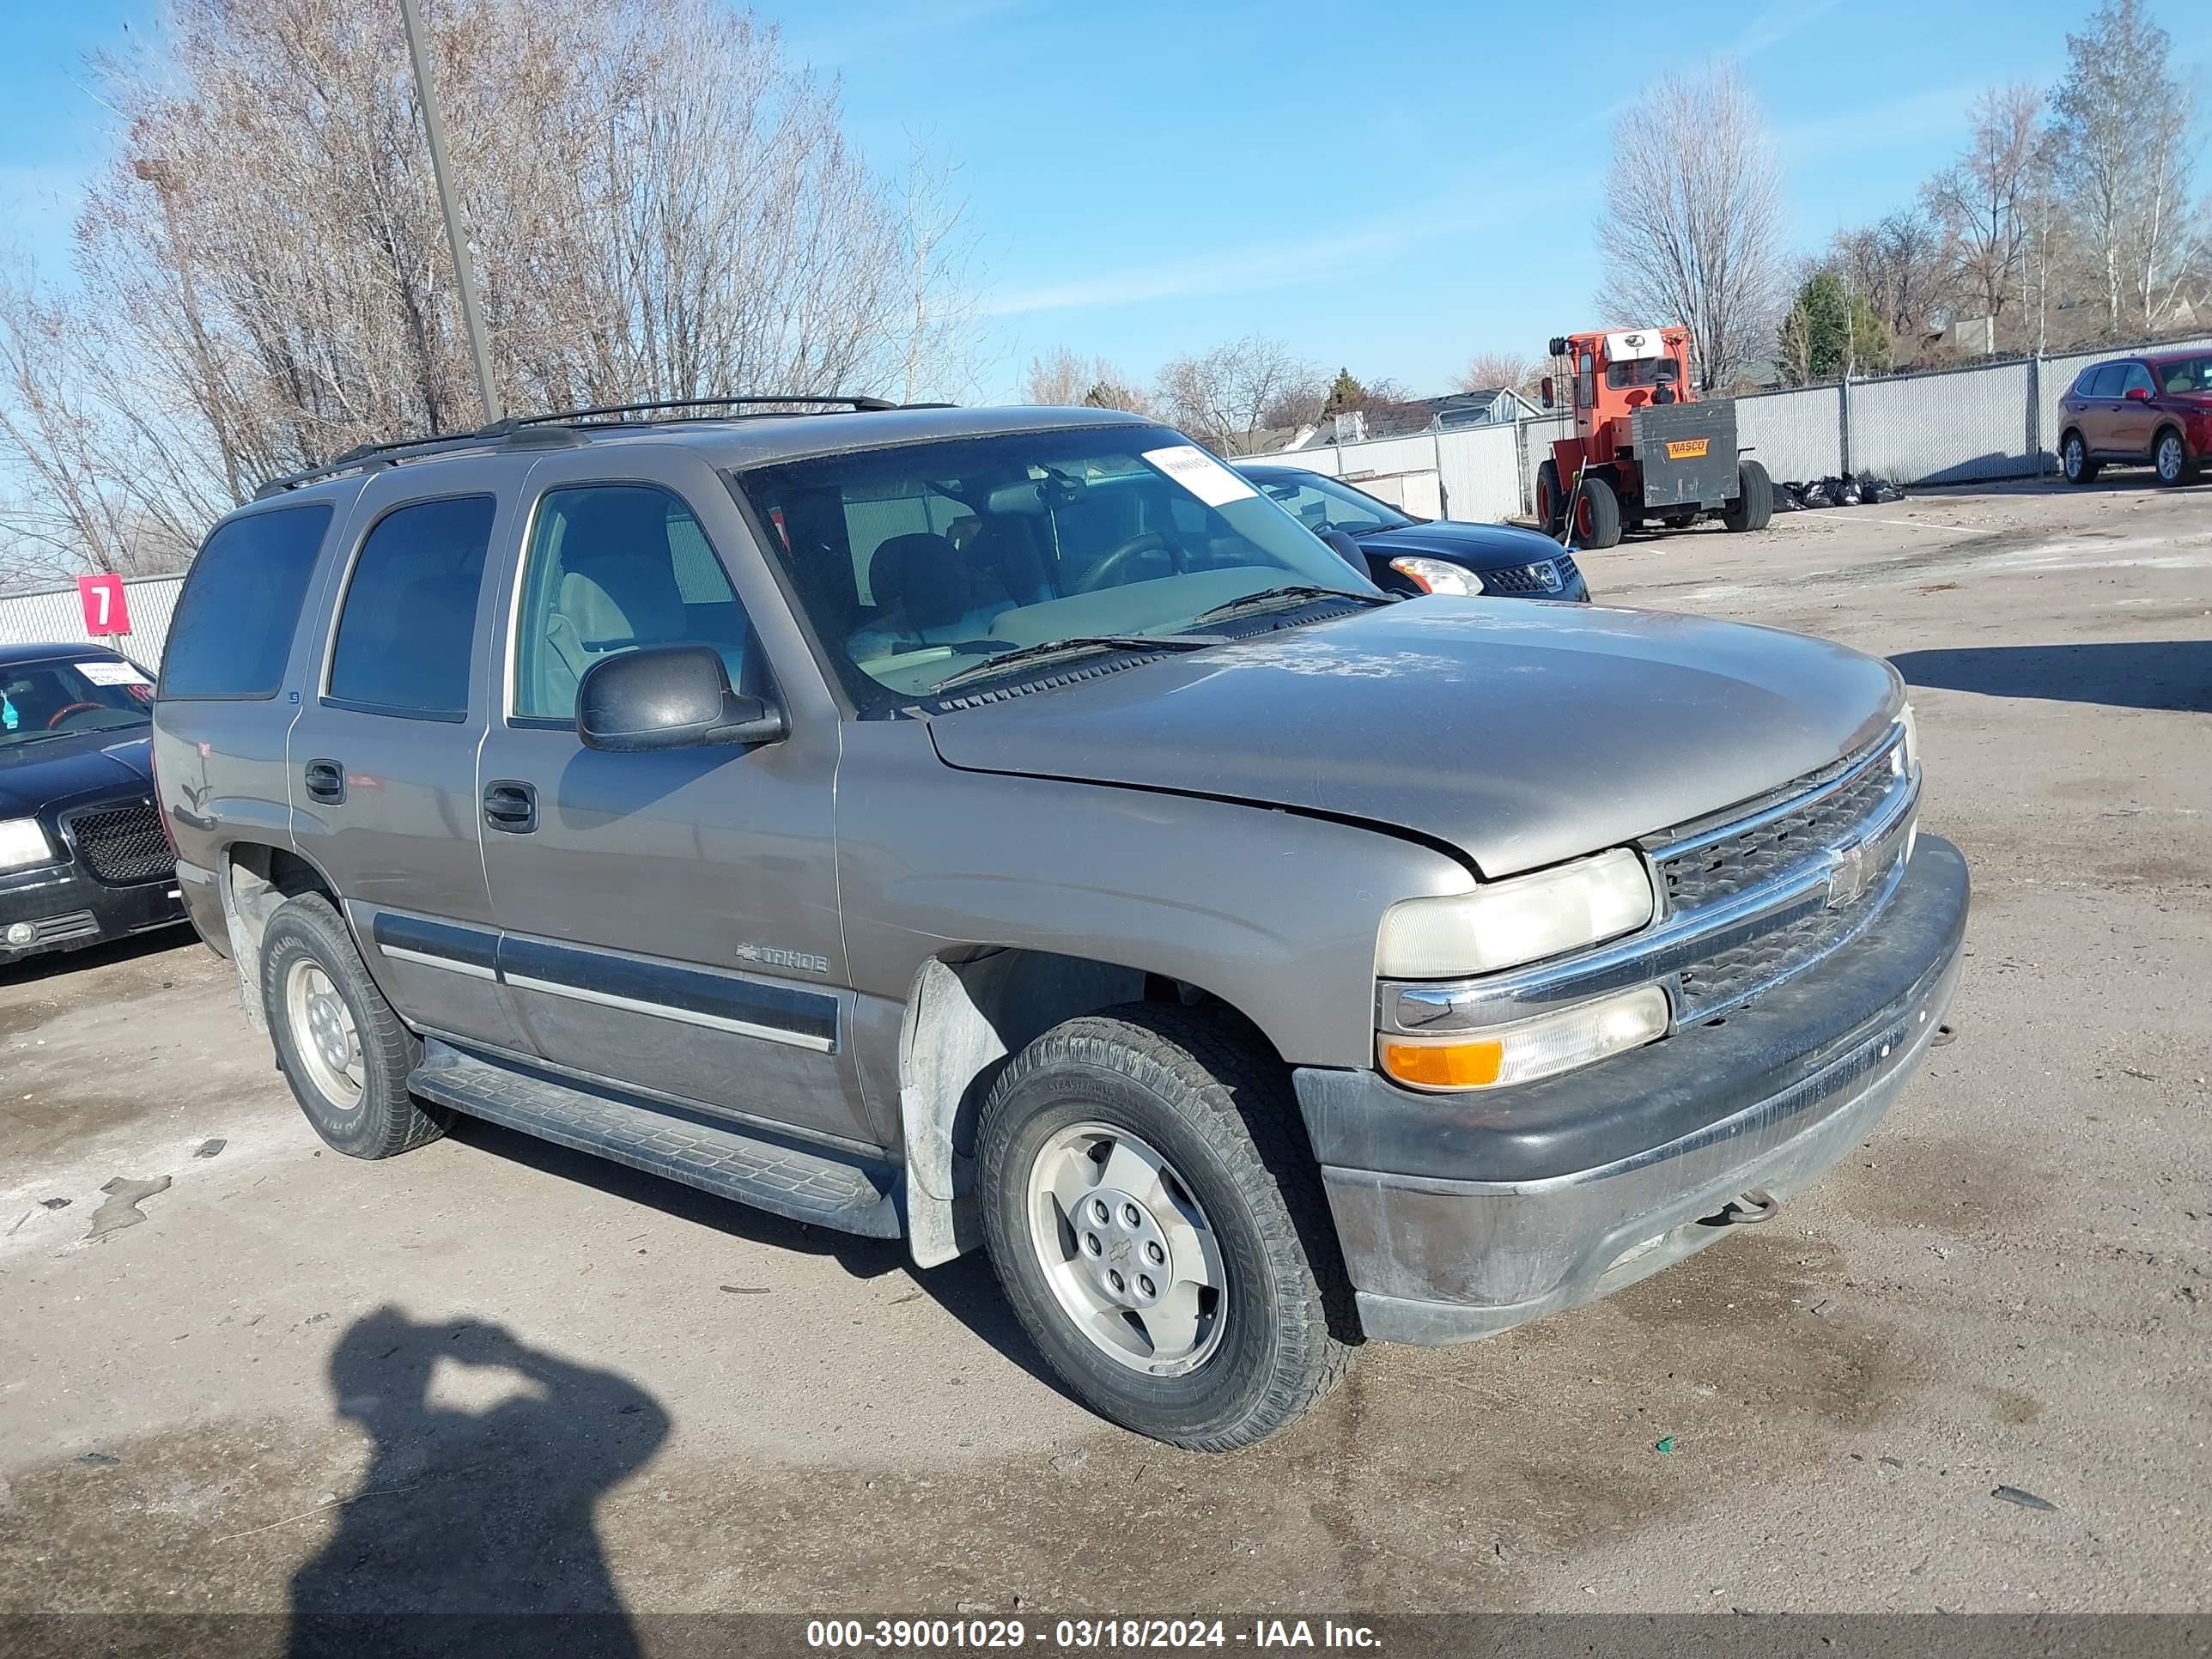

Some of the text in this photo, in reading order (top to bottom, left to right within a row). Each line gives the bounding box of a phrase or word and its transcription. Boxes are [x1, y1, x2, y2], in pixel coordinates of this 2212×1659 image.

[1670, 441, 1705, 453] NASCO
[90, 586, 111, 626] 7
[761, 946, 830, 973] TAHOE
[985, 1115, 1012, 1250] COUNTRY
[1207, 1180, 1262, 1308] RADIAL
[1235, 1323, 1261, 1390] XTX
